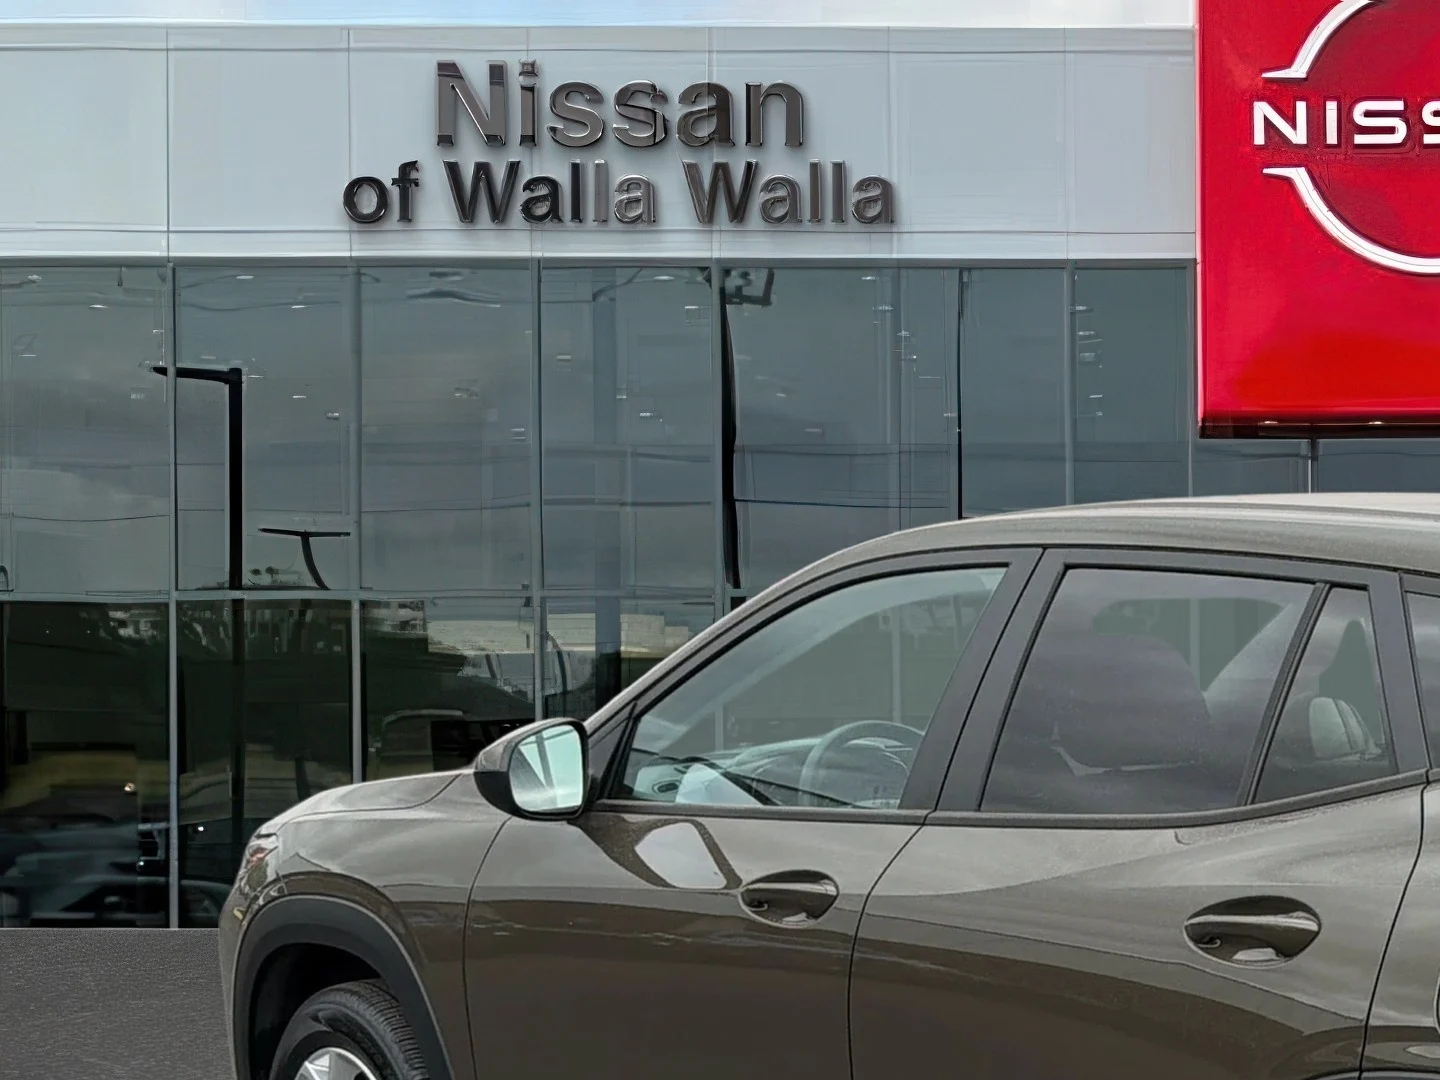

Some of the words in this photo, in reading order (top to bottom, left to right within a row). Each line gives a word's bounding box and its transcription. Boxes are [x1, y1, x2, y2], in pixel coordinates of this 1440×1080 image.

[436, 58, 805, 148] Nissan
[342, 159, 420, 224] of
[443, 158, 658, 225] Walla
[682, 158, 896, 225] Walla
